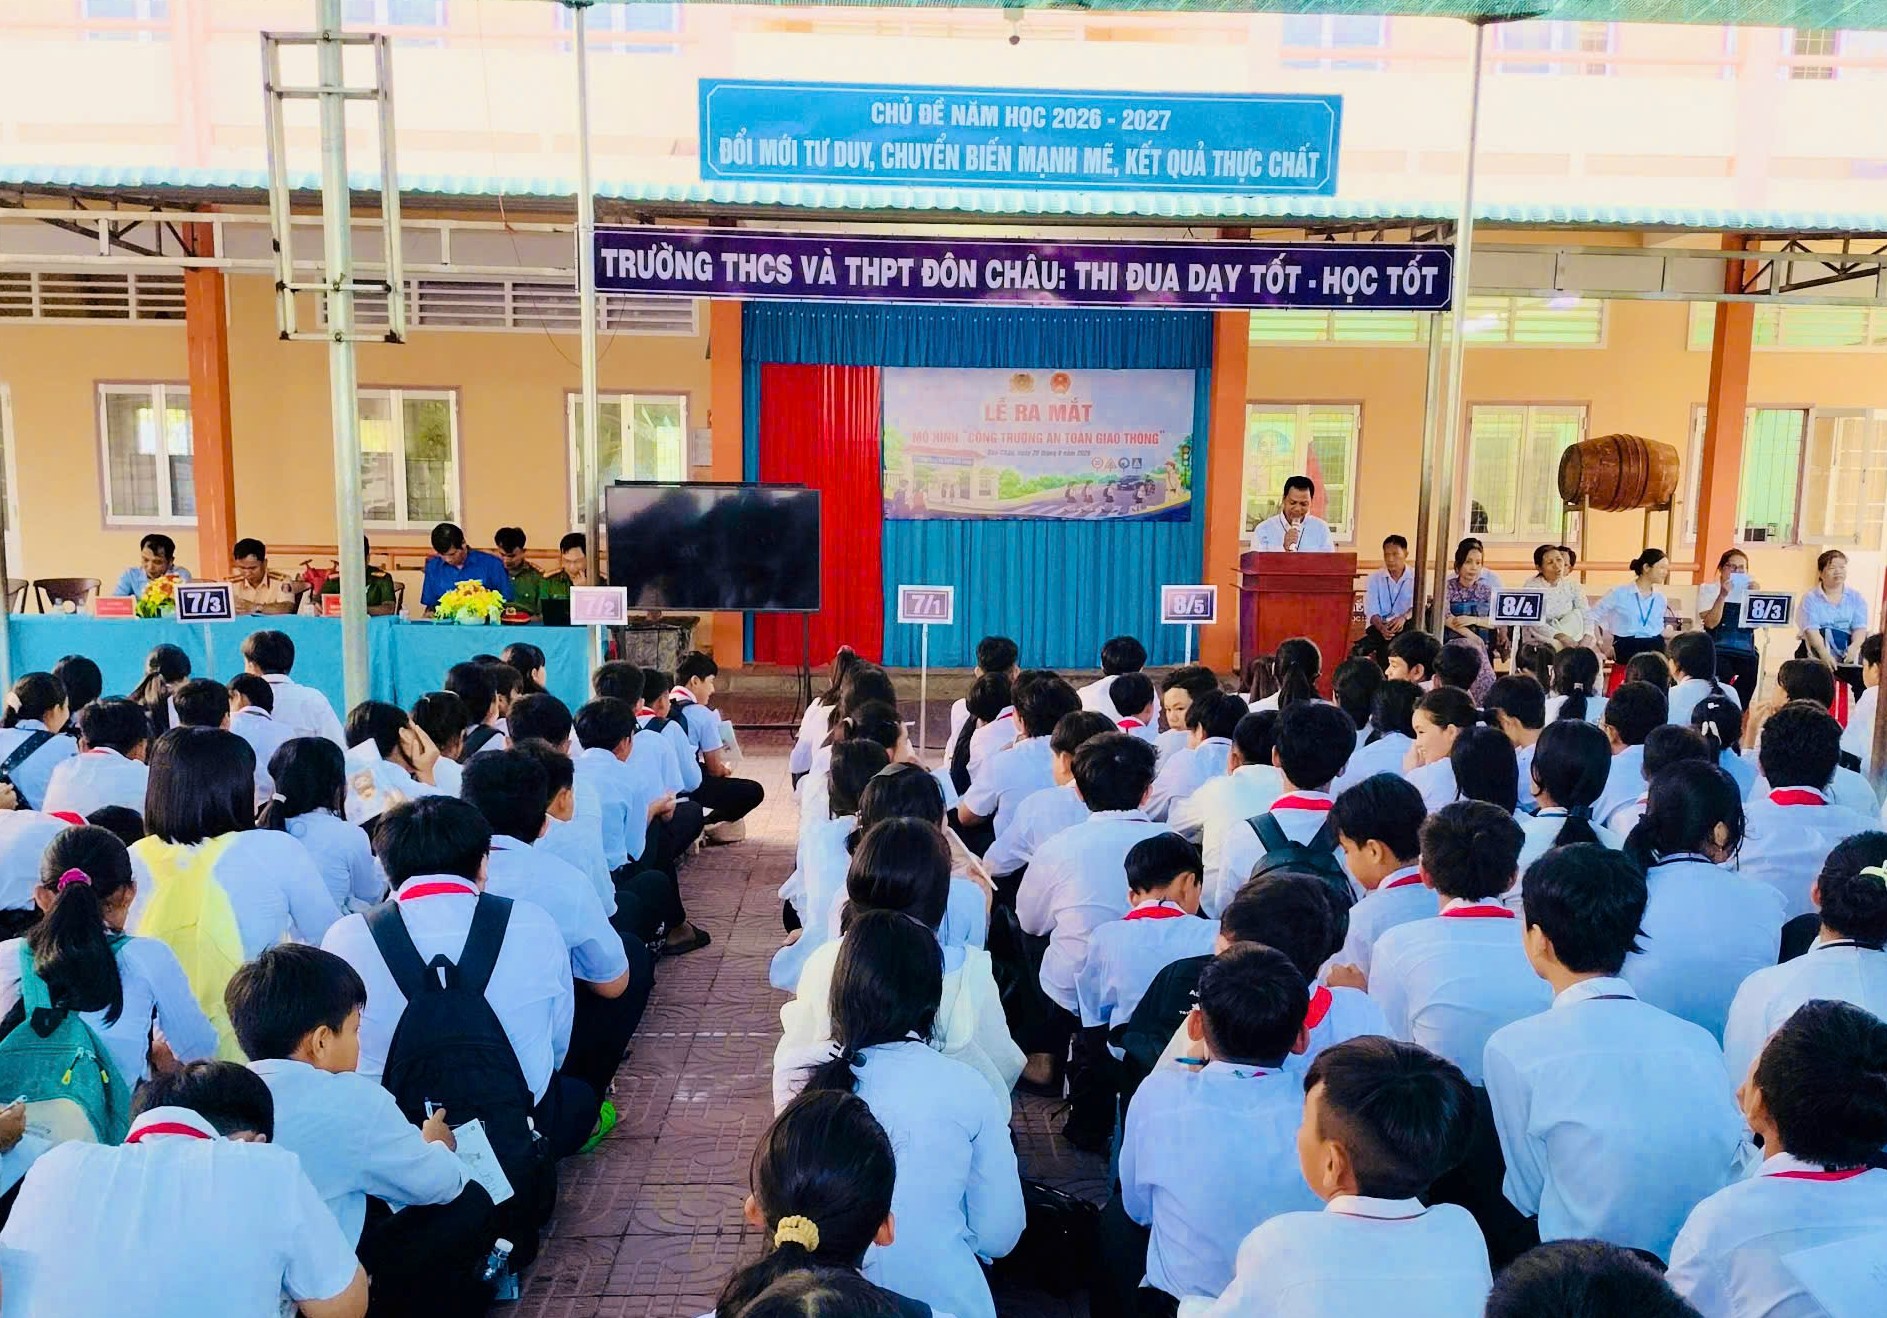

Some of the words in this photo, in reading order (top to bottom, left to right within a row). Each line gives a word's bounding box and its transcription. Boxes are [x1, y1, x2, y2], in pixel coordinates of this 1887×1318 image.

[871, 96, 912, 125] CHỦ
[918, 97, 945, 125] ĐỀ
[951, 100, 999, 127] NĂM
[1004, 105, 1046, 132] HỌC
[1052, 107, 1101, 130] 2026
[1121, 109, 1171, 131] 2027
[719, 127, 753, 165] ĐỔI
[759, 134, 798, 167] MỚI
[804, 138, 830, 167] TƯ
[834, 141, 875, 172] DUY,
[881, 132, 960, 170] CHUYỂN
[966, 136, 1012, 172] BIẾN
[1018, 145, 1078, 178] MẠNH
[1083, 142, 1119, 177] MẼ,
[1125, 140, 1162, 175] KẾT
[1166, 140, 1207, 179] QUẢ
[1212, 148, 1263, 183] THỰC
[1268, 142, 1321, 179] CHẤT
[601, 242, 713, 281] TRƯỜNG
[721, 252, 793, 285] THCS
[800, 247, 837, 285] VÀ
[845, 256, 914, 287] THPT
[921, 252, 977, 289] ĐÔN
[985, 253, 1066, 290] CHÂU:
[1074, 261, 1118, 291] THI
[1125, 262, 1180, 292] ĐUA
[1188, 263, 1243, 301] DẠY
[1250, 252, 1302, 294] TỐT
[1322, 265, 1378, 303] HỌC
[1386, 254, 1439, 295] TỐT
[984, 397, 1008, 421] LỄ
[1014, 403, 1041, 421] RA
[1048, 397, 1093, 422] MẮT
[1096, 431, 1121, 444] GIAO
[187, 592, 221, 613] 7/3
[585, 595, 616, 616] 7/2
[911, 595, 940, 615] 7/1
[1173, 594, 1204, 615] 8/5
[1502, 597, 1533, 616] 8/4
[1751, 600, 1782, 620] 8/3
